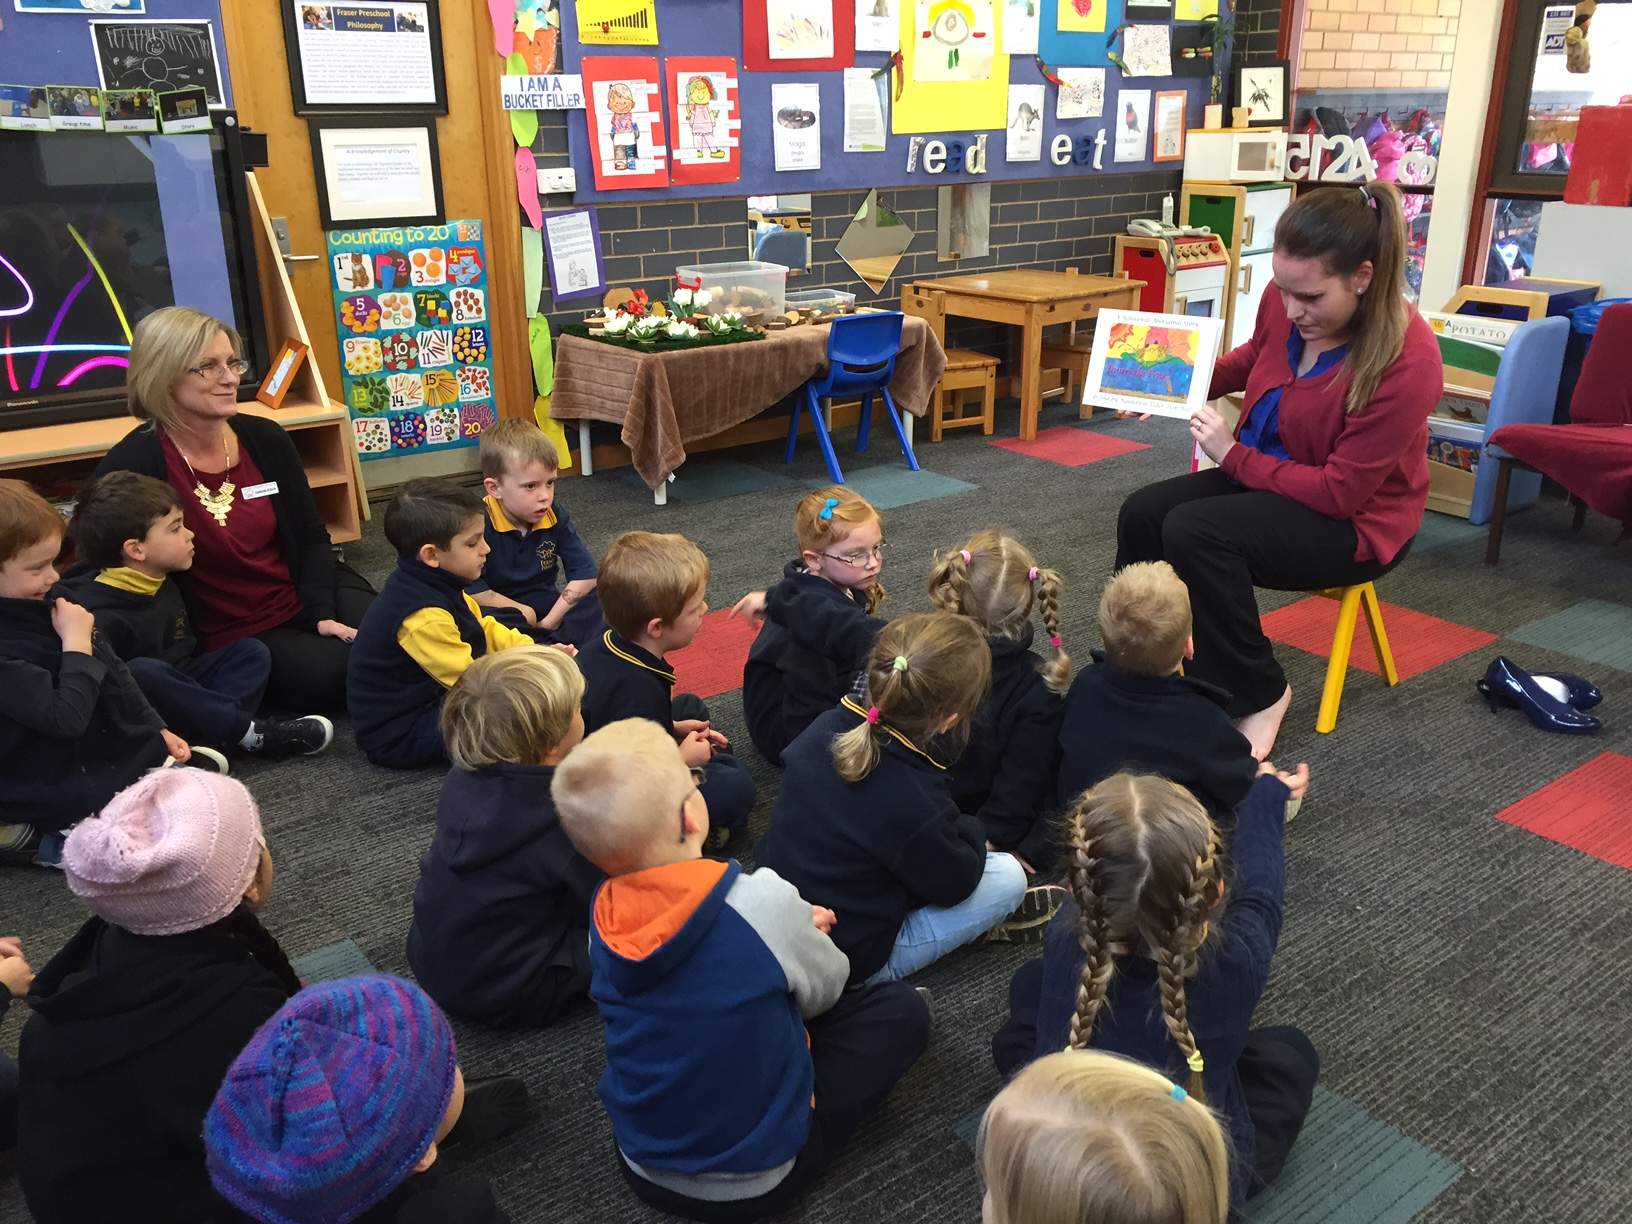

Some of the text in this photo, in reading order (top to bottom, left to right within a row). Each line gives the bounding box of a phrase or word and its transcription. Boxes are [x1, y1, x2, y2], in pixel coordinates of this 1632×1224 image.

[358, 9, 391, 17] Preschool
[346, 21, 384, 30] Philosophy
[1545, 36, 1565, 48] ADT
[520, 77, 563, 92] I AM A
[504, 94, 543, 109] BUCKET
[906, 134, 989, 175] read
[1050, 128, 1107, 170] eat
[329, 226, 449, 246] Counting to 20
[449, 249, 459, 262] 4
[396, 258, 406, 272] 2
[415, 271, 424, 283] 3
[356, 298, 365, 311] 5
[417, 293, 426, 307] 7
[392, 313, 401, 326] 6
[456, 309, 464, 321] 8
[471, 329, 484, 342] 12
[1452, 325, 1506, 339] POTATO
[345, 341, 355, 353] 9
[393, 342, 408, 356] 10
[422, 353, 431, 365] 11
[425, 373, 437, 386] 15
[352, 389, 367, 403] 13
[460, 383, 471, 396] 16
[391, 395, 405, 407] 14
[355, 420, 368, 433] 17
[400, 420, 414, 433] 18
[430, 424, 443, 437] 19
[463, 422, 481, 435] 20
